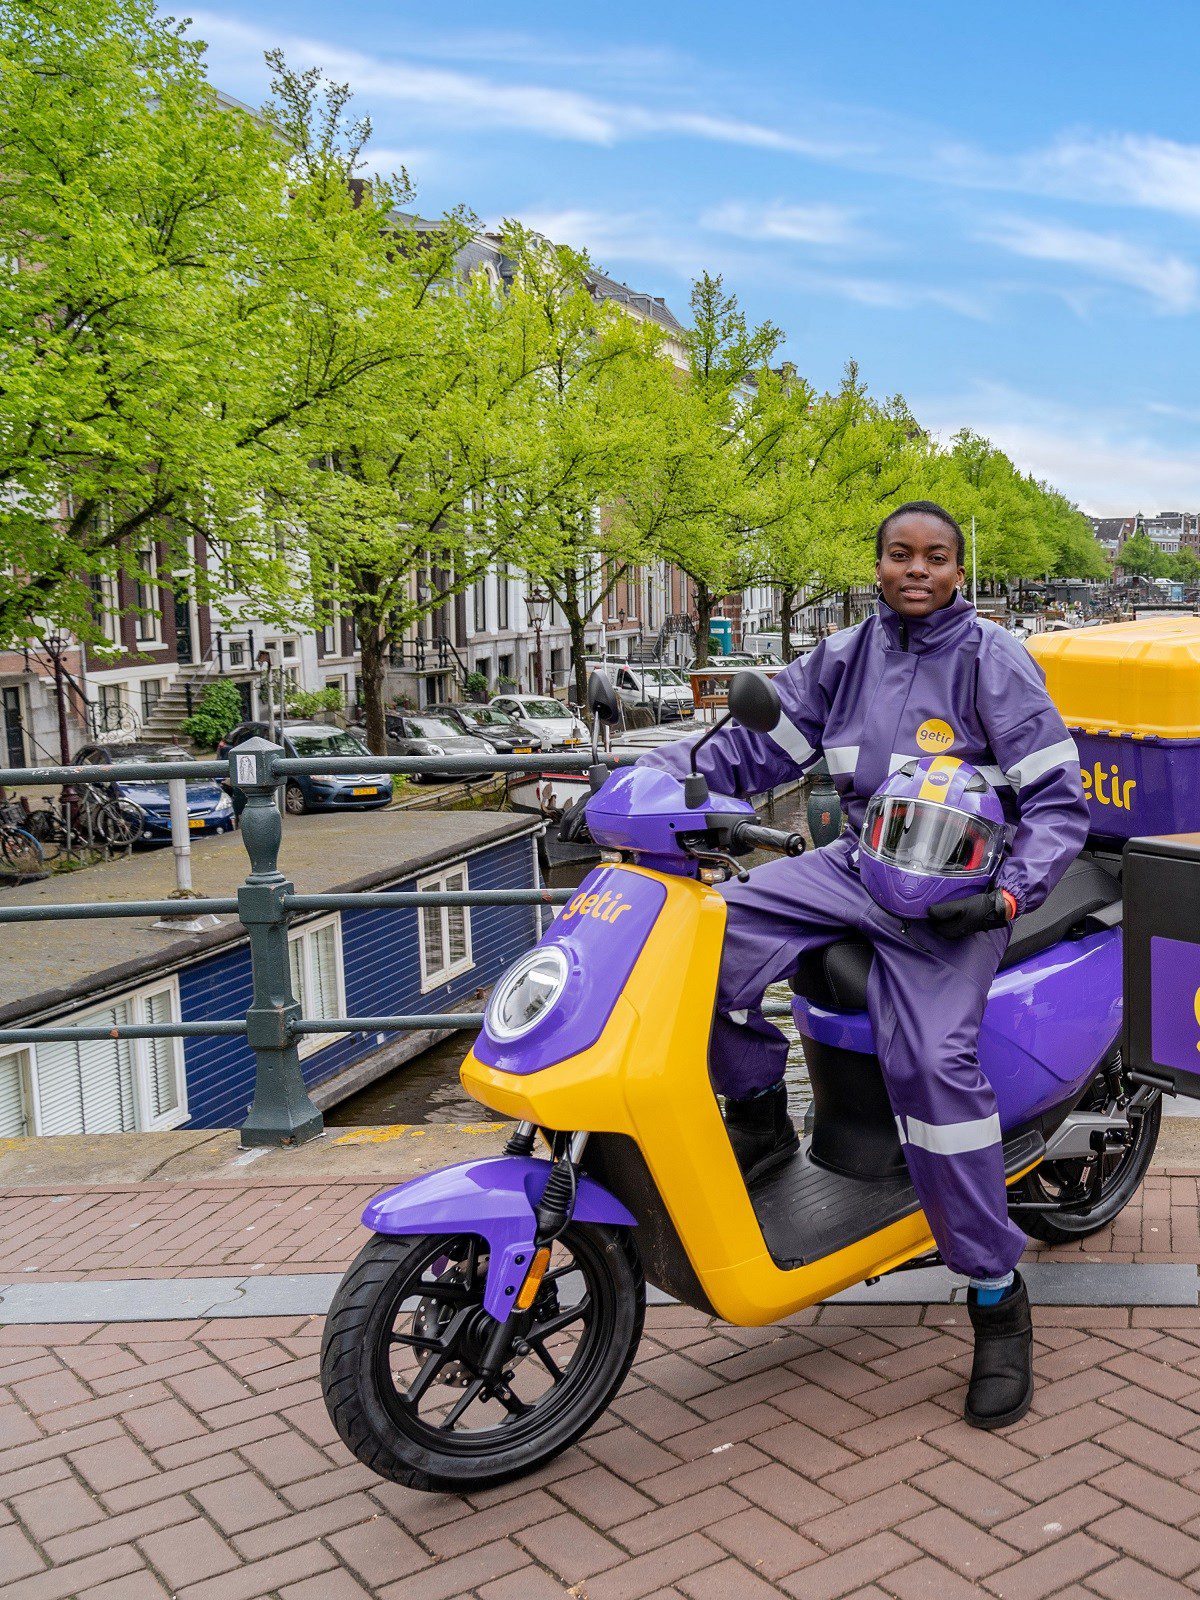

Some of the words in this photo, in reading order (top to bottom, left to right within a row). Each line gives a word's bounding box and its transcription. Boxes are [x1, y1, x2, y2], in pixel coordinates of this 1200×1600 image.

[920, 729, 951, 744] getir
[1080, 761, 1137, 811] etir
[562, 890, 632, 924] getir
